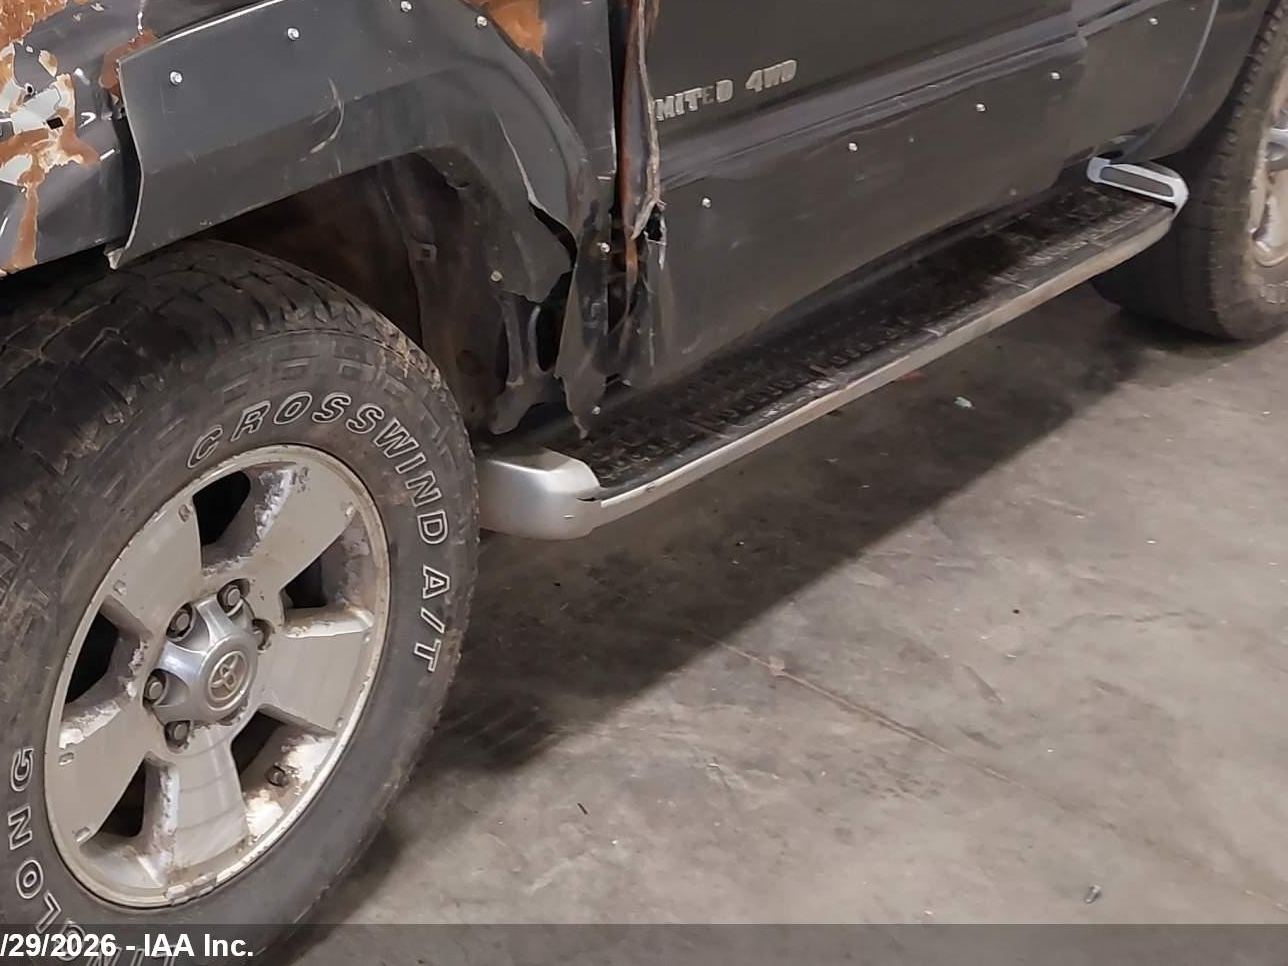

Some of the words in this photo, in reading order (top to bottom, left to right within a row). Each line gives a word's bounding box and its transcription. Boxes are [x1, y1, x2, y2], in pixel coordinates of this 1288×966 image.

[655, 79, 733, 121] MITED
[187, 391, 449, 545] CROSSWIND
[413, 564, 451, 673] A/T
